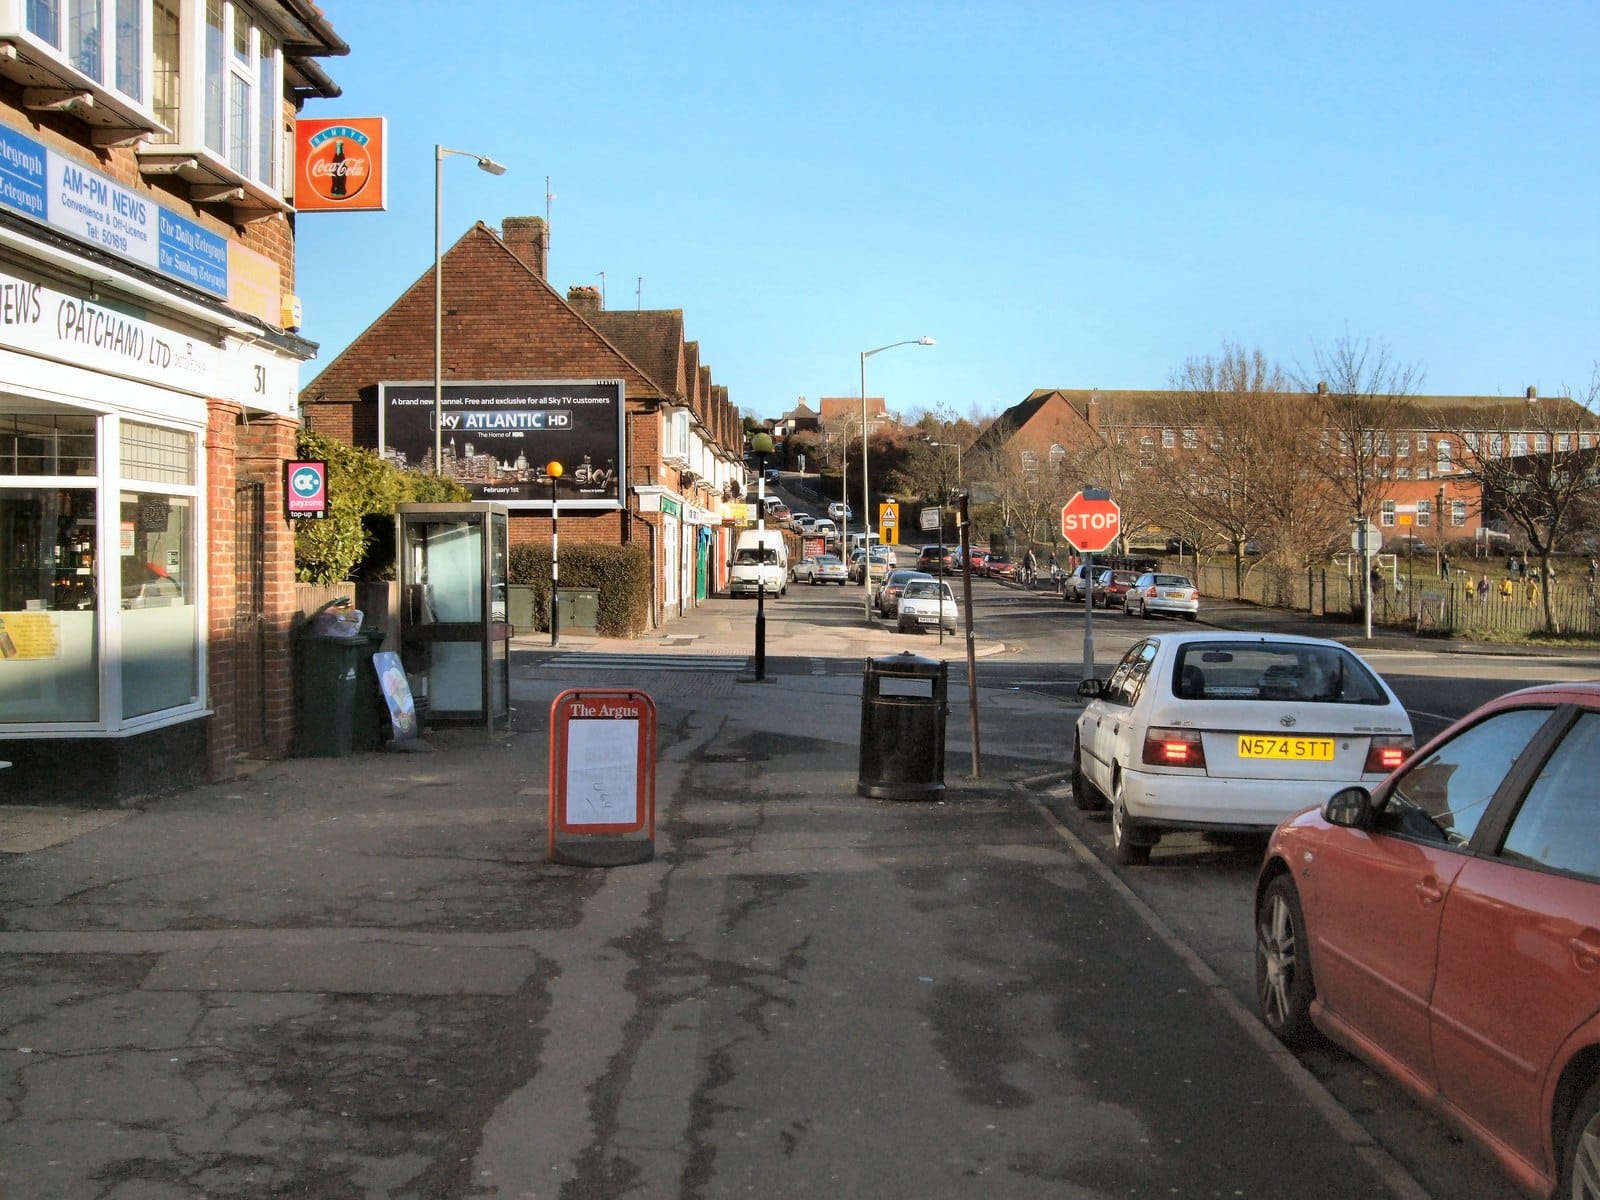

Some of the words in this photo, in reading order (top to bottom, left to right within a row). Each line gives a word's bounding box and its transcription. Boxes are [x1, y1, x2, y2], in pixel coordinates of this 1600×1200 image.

[63, 165, 107, 209] AM-PM
[112, 188, 146, 226] NEWS
[61, 192, 103, 222] Convenience
[105, 212, 111, 226] &
[112, 215, 147, 242] Off-Licence
[102, 228, 127, 252] 501619
[160, 216, 174, 236] The
[175, 224, 193, 250] Daily
[194, 231, 226, 262] Telegraph
[160, 248, 173, 269] The
[174, 254, 198, 281] Sunday
[199, 265, 226, 289] Telegraph
[0, 282, 41, 325] EWS
[57, 298, 144, 361] (PATCHAM)
[149, 335, 171, 369] LTD
[254, 364, 266, 395] 31
[398, 398, 419, 406] brand
[527, 397, 538, 405] for
[548, 397, 561, 406] Sky
[572, 397, 610, 405] customers
[466, 413, 542, 428] ATLANTIC
[548, 415, 568, 426] HD
[575, 463, 613, 488] sky
[290, 500, 323, 508] payzone
[1065, 513, 1117, 530] STOP
[570, 704, 596, 717] The
[598, 704, 639, 719] Argus
[1240, 740, 1289, 756] N574
[1296, 742, 1331, 757] STT
